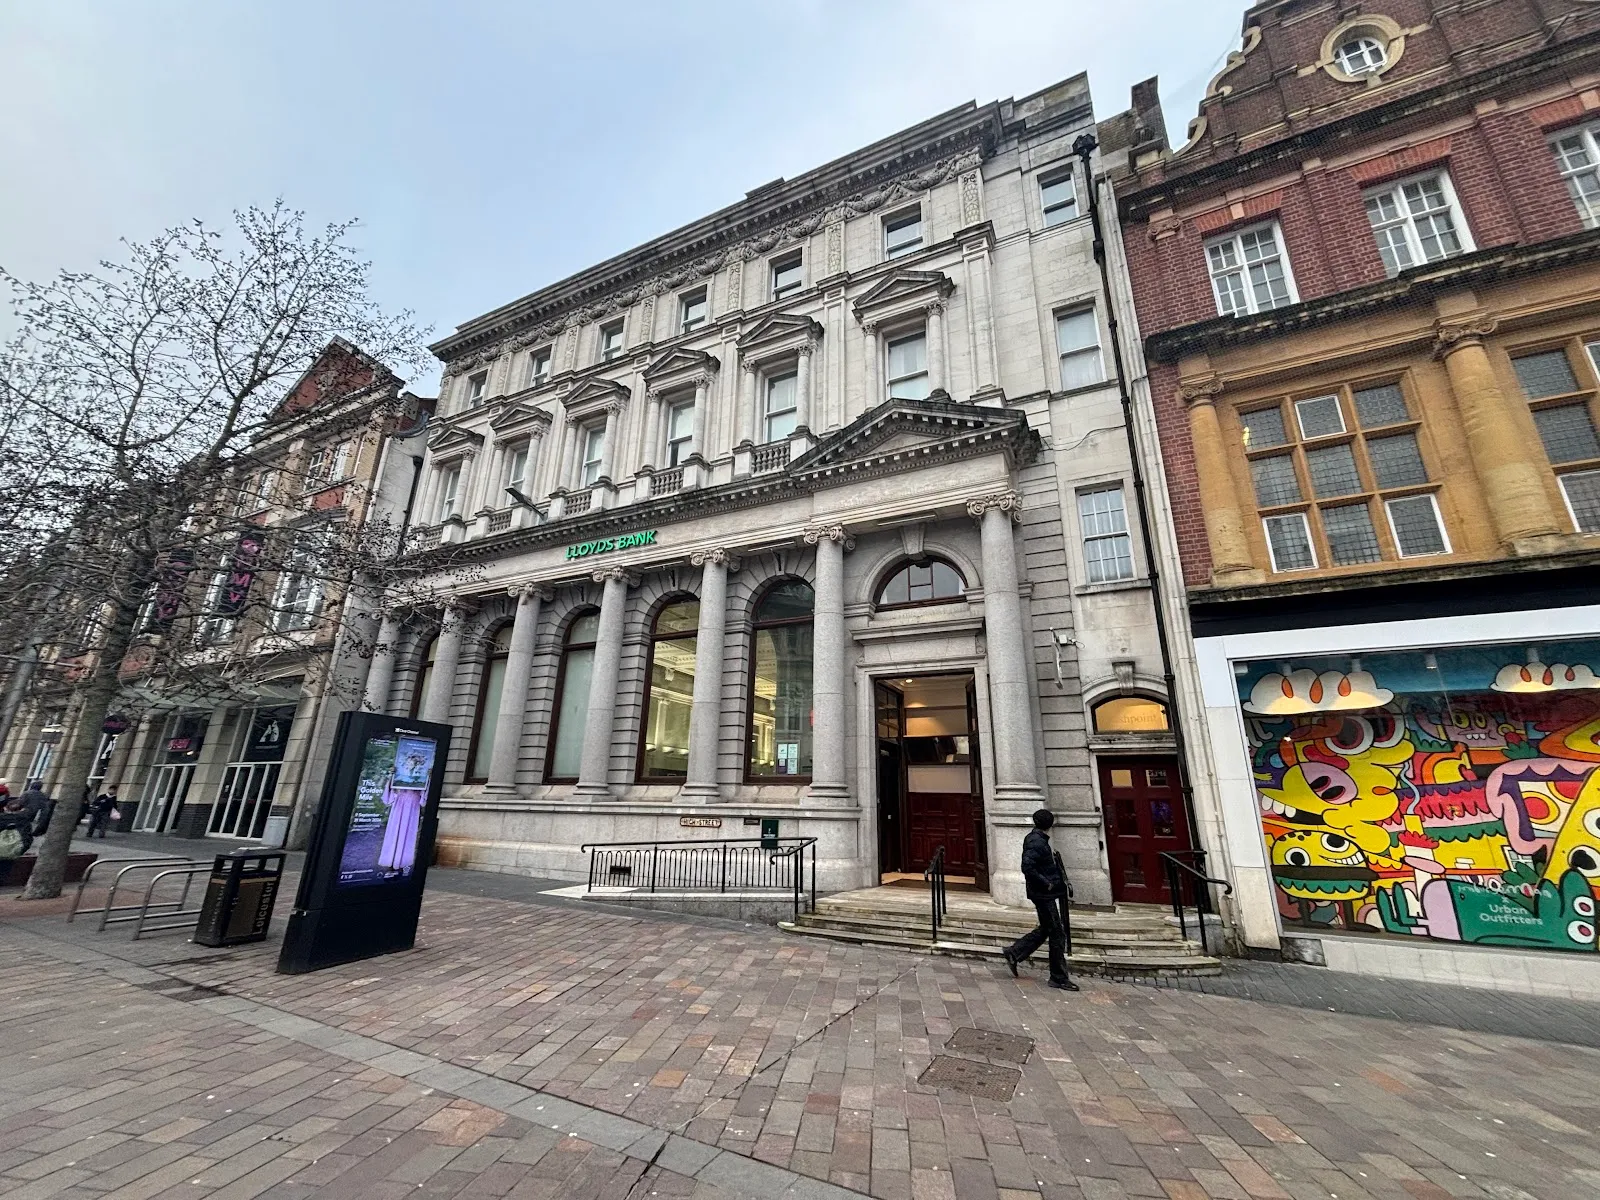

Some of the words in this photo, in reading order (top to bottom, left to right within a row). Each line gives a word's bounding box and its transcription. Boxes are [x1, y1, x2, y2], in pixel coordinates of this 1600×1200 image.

[564, 539, 615, 561] LLOYDS
[617, 530, 658, 549] BANK
[362, 779, 376, 787] This
[360, 786, 383, 795] Golden
[358, 793, 374, 801] Mile
[683, 818, 696, 826] HIGH
[698, 819, 719, 827] STREET
[253, 881, 275, 935] Leicester
[1489, 904, 1527, 914] Urban
[1479, 913, 1543, 925] Outfitters
